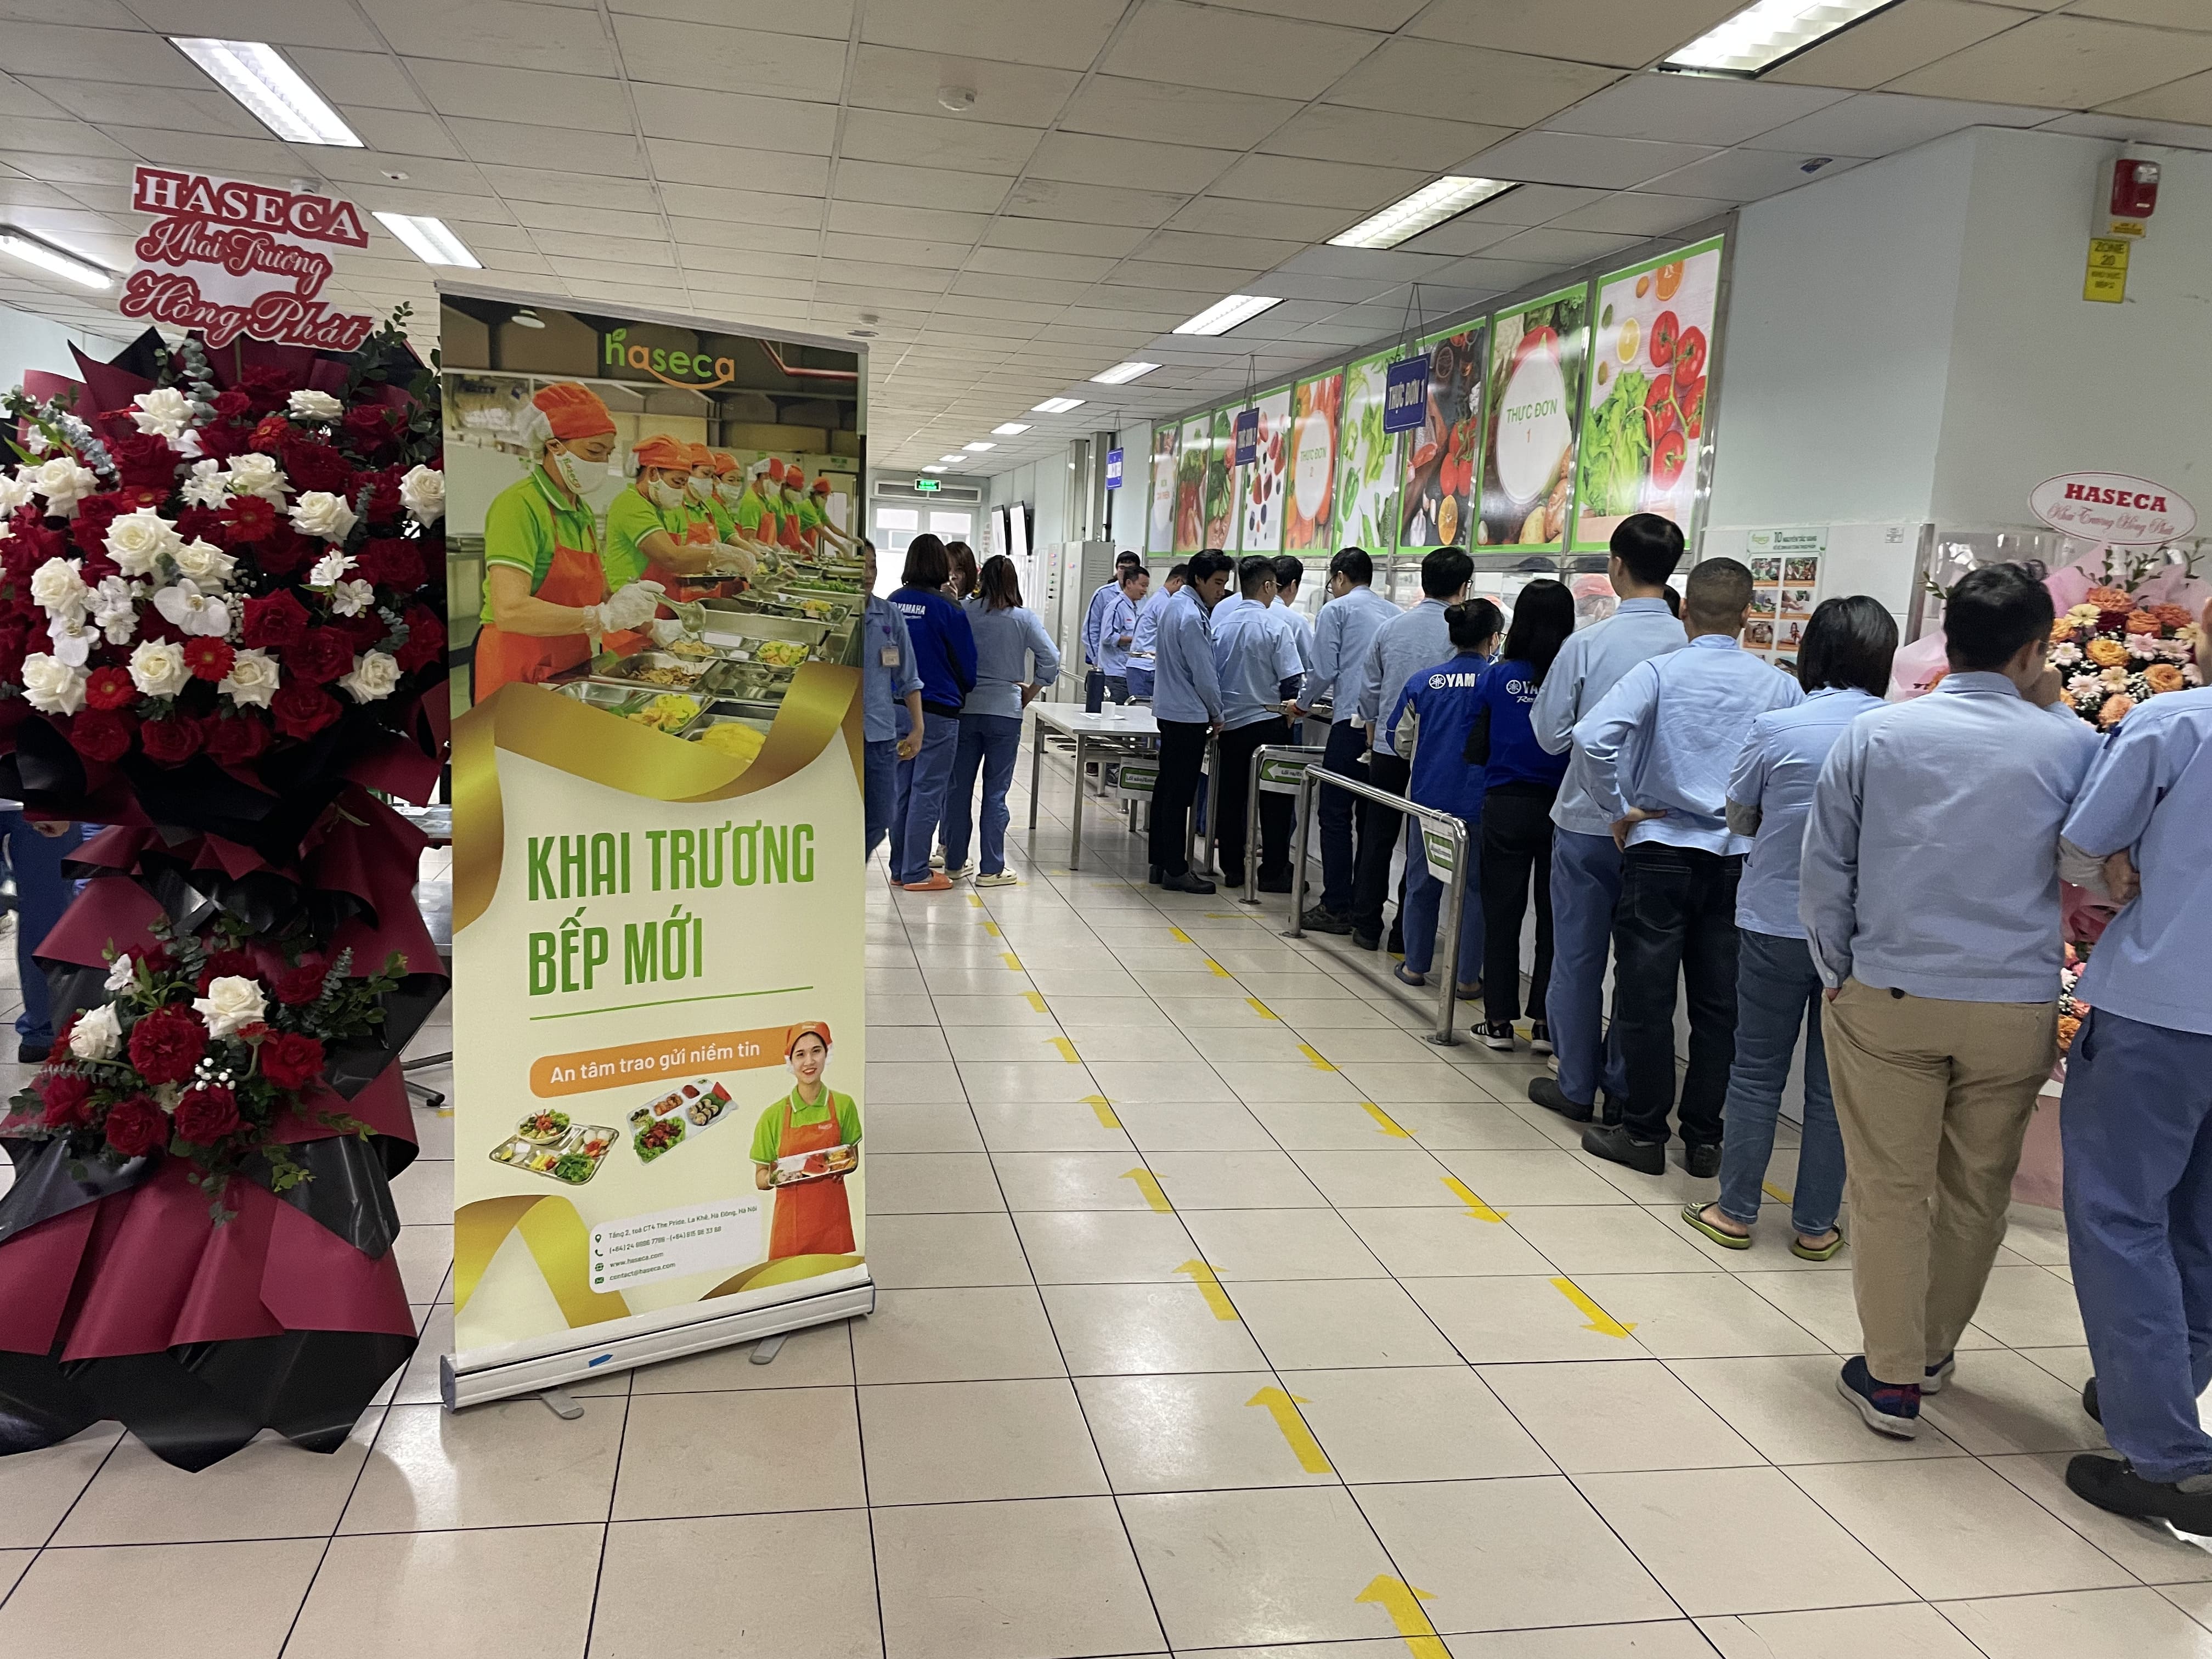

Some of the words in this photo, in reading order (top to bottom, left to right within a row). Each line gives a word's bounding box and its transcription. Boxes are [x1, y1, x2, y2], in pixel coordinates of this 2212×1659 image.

[143, 175, 361, 240] HASECA
[141, 221, 223, 261] Khai
[229, 235, 326, 295] Trương
[125, 273, 245, 341] Hồng
[253, 297, 364, 345] Phát
[606, 329, 735, 384] haseca
[1507, 404, 1532, 425] THỰC
[1534, 399, 1558, 417] ĐƠN
[1527, 429, 1531, 443] 1
[2064, 483, 2166, 512] HASECA
[1774, 532, 1782, 543] 10
[898, 603, 926, 615] YAMAHA
[1446, 673, 1480, 687] YAM
[1522, 681, 1539, 695] YA
[528, 832, 630, 901] KHAI
[646, 820, 814, 891] TRƯƠNG
[529, 907, 608, 996] BẾP
[624, 904, 703, 985] MỚI
[550, 1066, 575, 1084] An
[580, 1059, 615, 1079] tâm
[620, 1054, 654, 1073] trao
[659, 1048, 686, 1071] gửi
[690, 1043, 733, 1064] niềm
[738, 1041, 760, 1057] tin
[610, 1252, 664, 1267] www.haseca.com
[610, 1263, 676, 1280] contact@haseca.com
